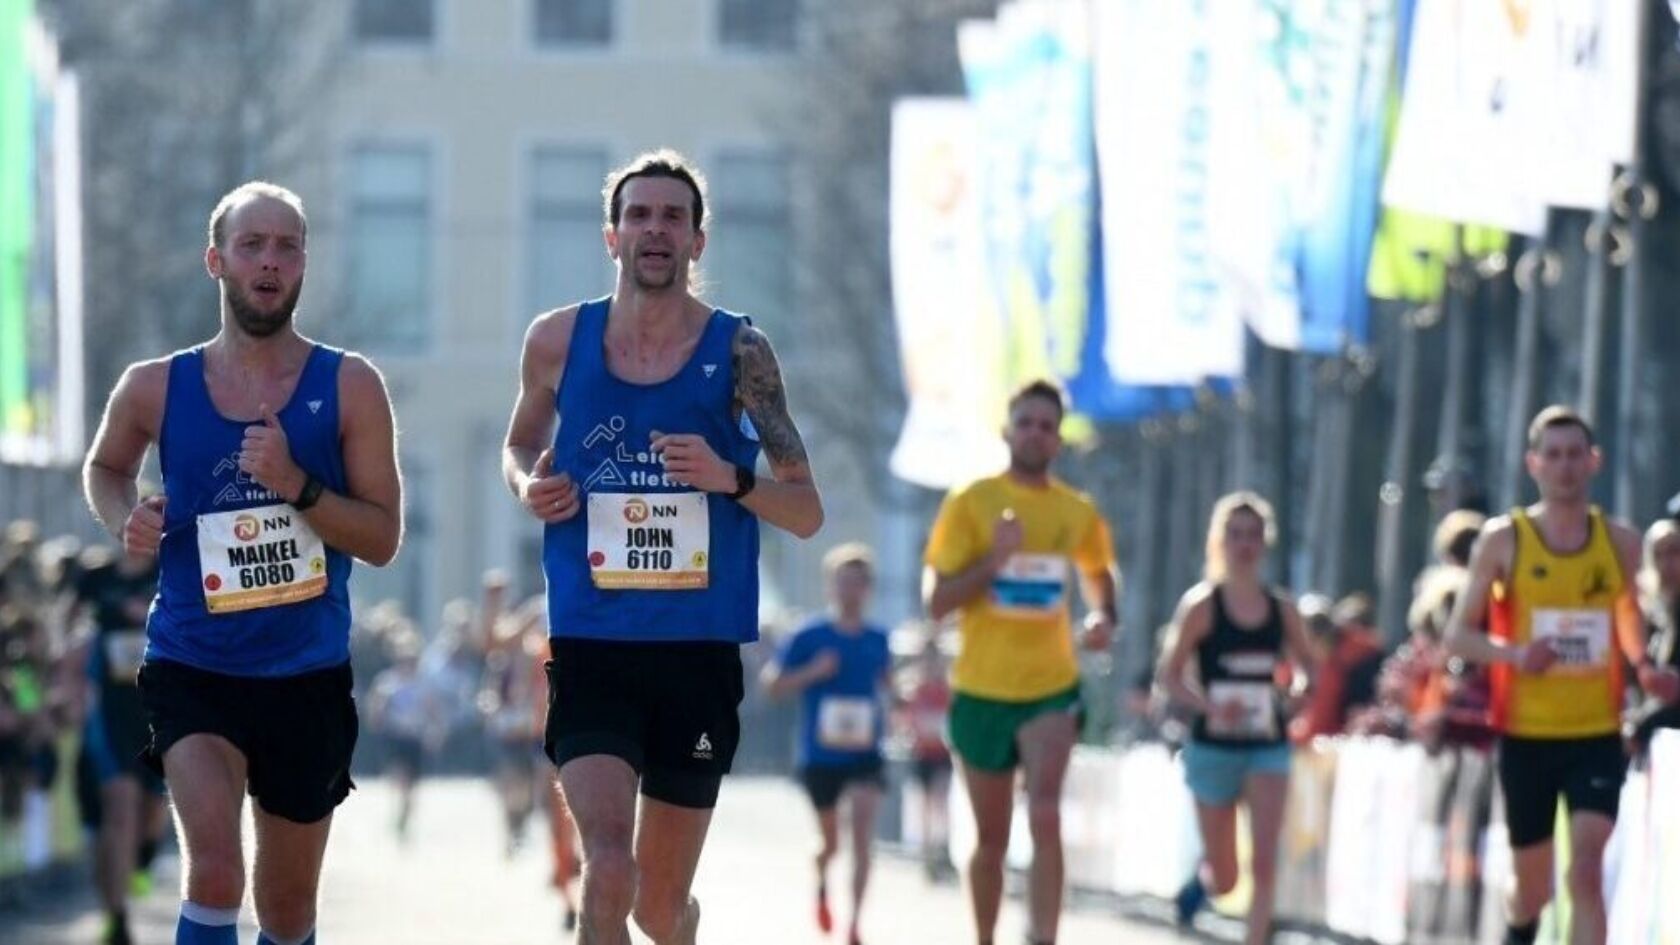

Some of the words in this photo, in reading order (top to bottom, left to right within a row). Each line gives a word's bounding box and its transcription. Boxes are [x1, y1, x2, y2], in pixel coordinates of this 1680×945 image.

[652, 505, 677, 517] NN
[263, 515, 291, 532] NN
[626, 527, 673, 548] JOHN
[227, 538, 300, 567] MAIKEL
[627, 549, 672, 570] 6110
[239, 563, 294, 589] 6080
